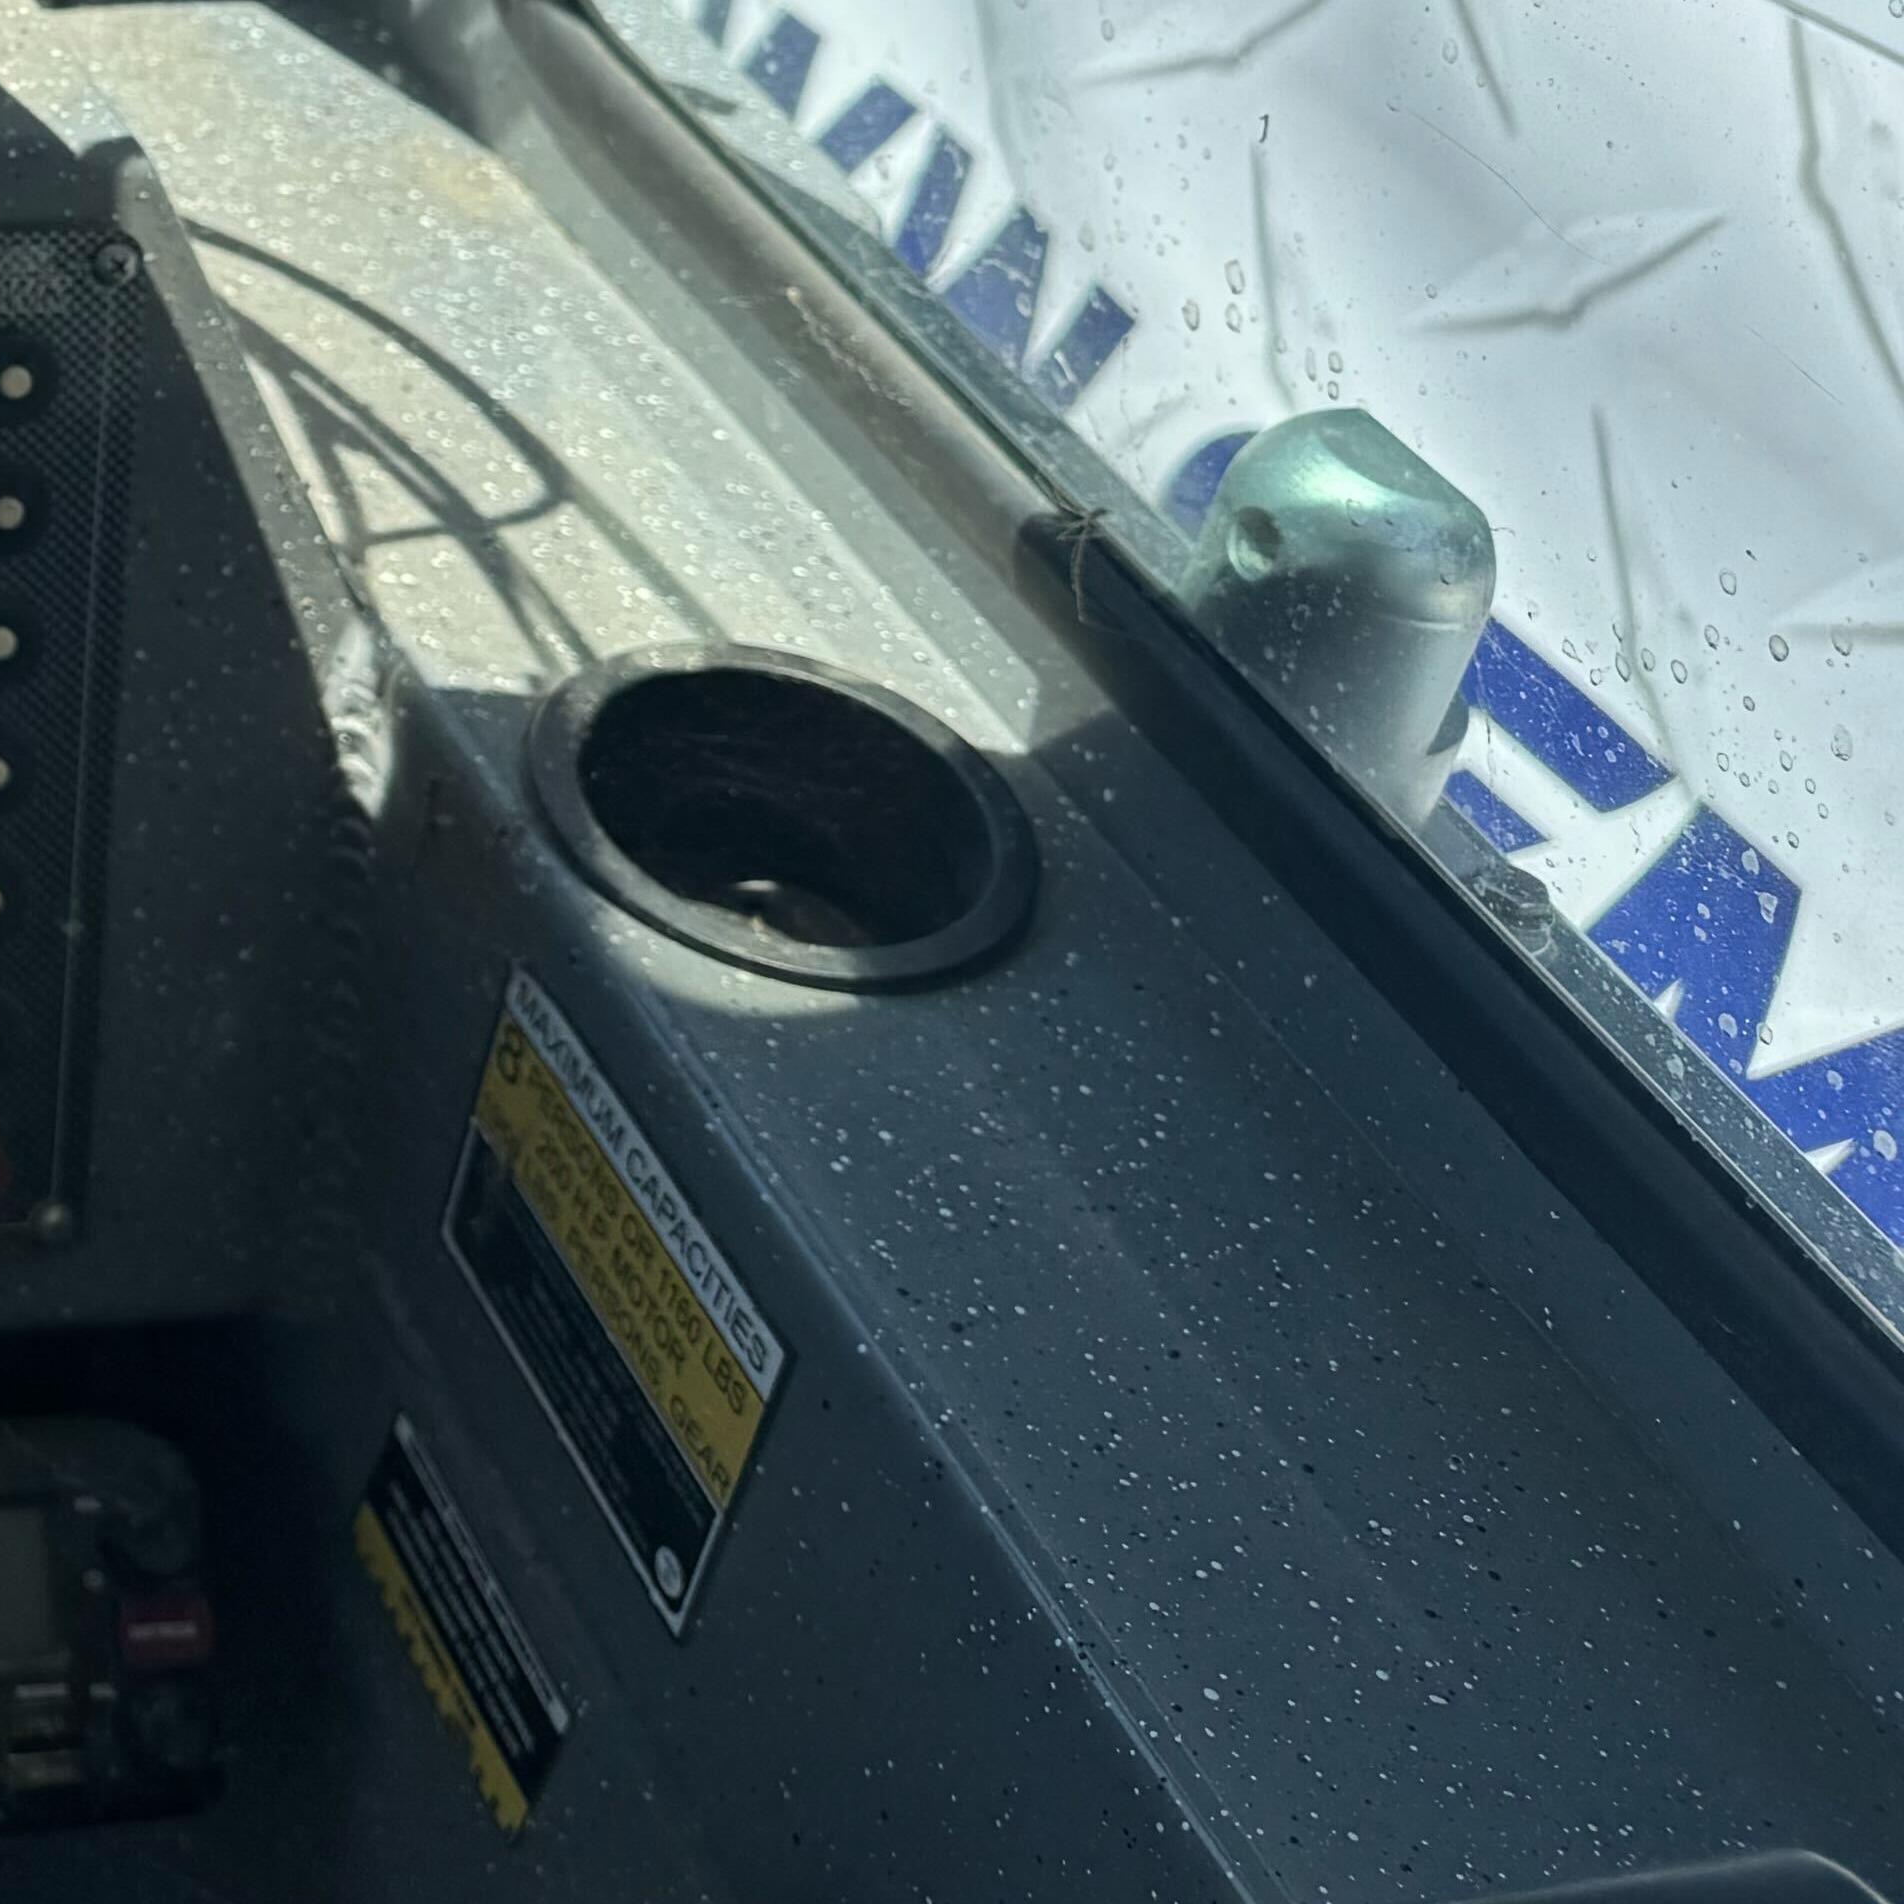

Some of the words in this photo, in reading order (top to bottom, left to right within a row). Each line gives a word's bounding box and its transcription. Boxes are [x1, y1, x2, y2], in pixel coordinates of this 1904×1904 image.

[496, 1021, 525, 1086] 8
[620, 1211, 654, 1271] OR
[701, 1336, 748, 1416] LBS
[514, 980, 626, 1156] MAXIMUM
[626, 1146, 768, 1374] CAPACITIES
[612, 1246, 686, 1378] MOTOR
[668, 1393, 731, 1492] GEAR
